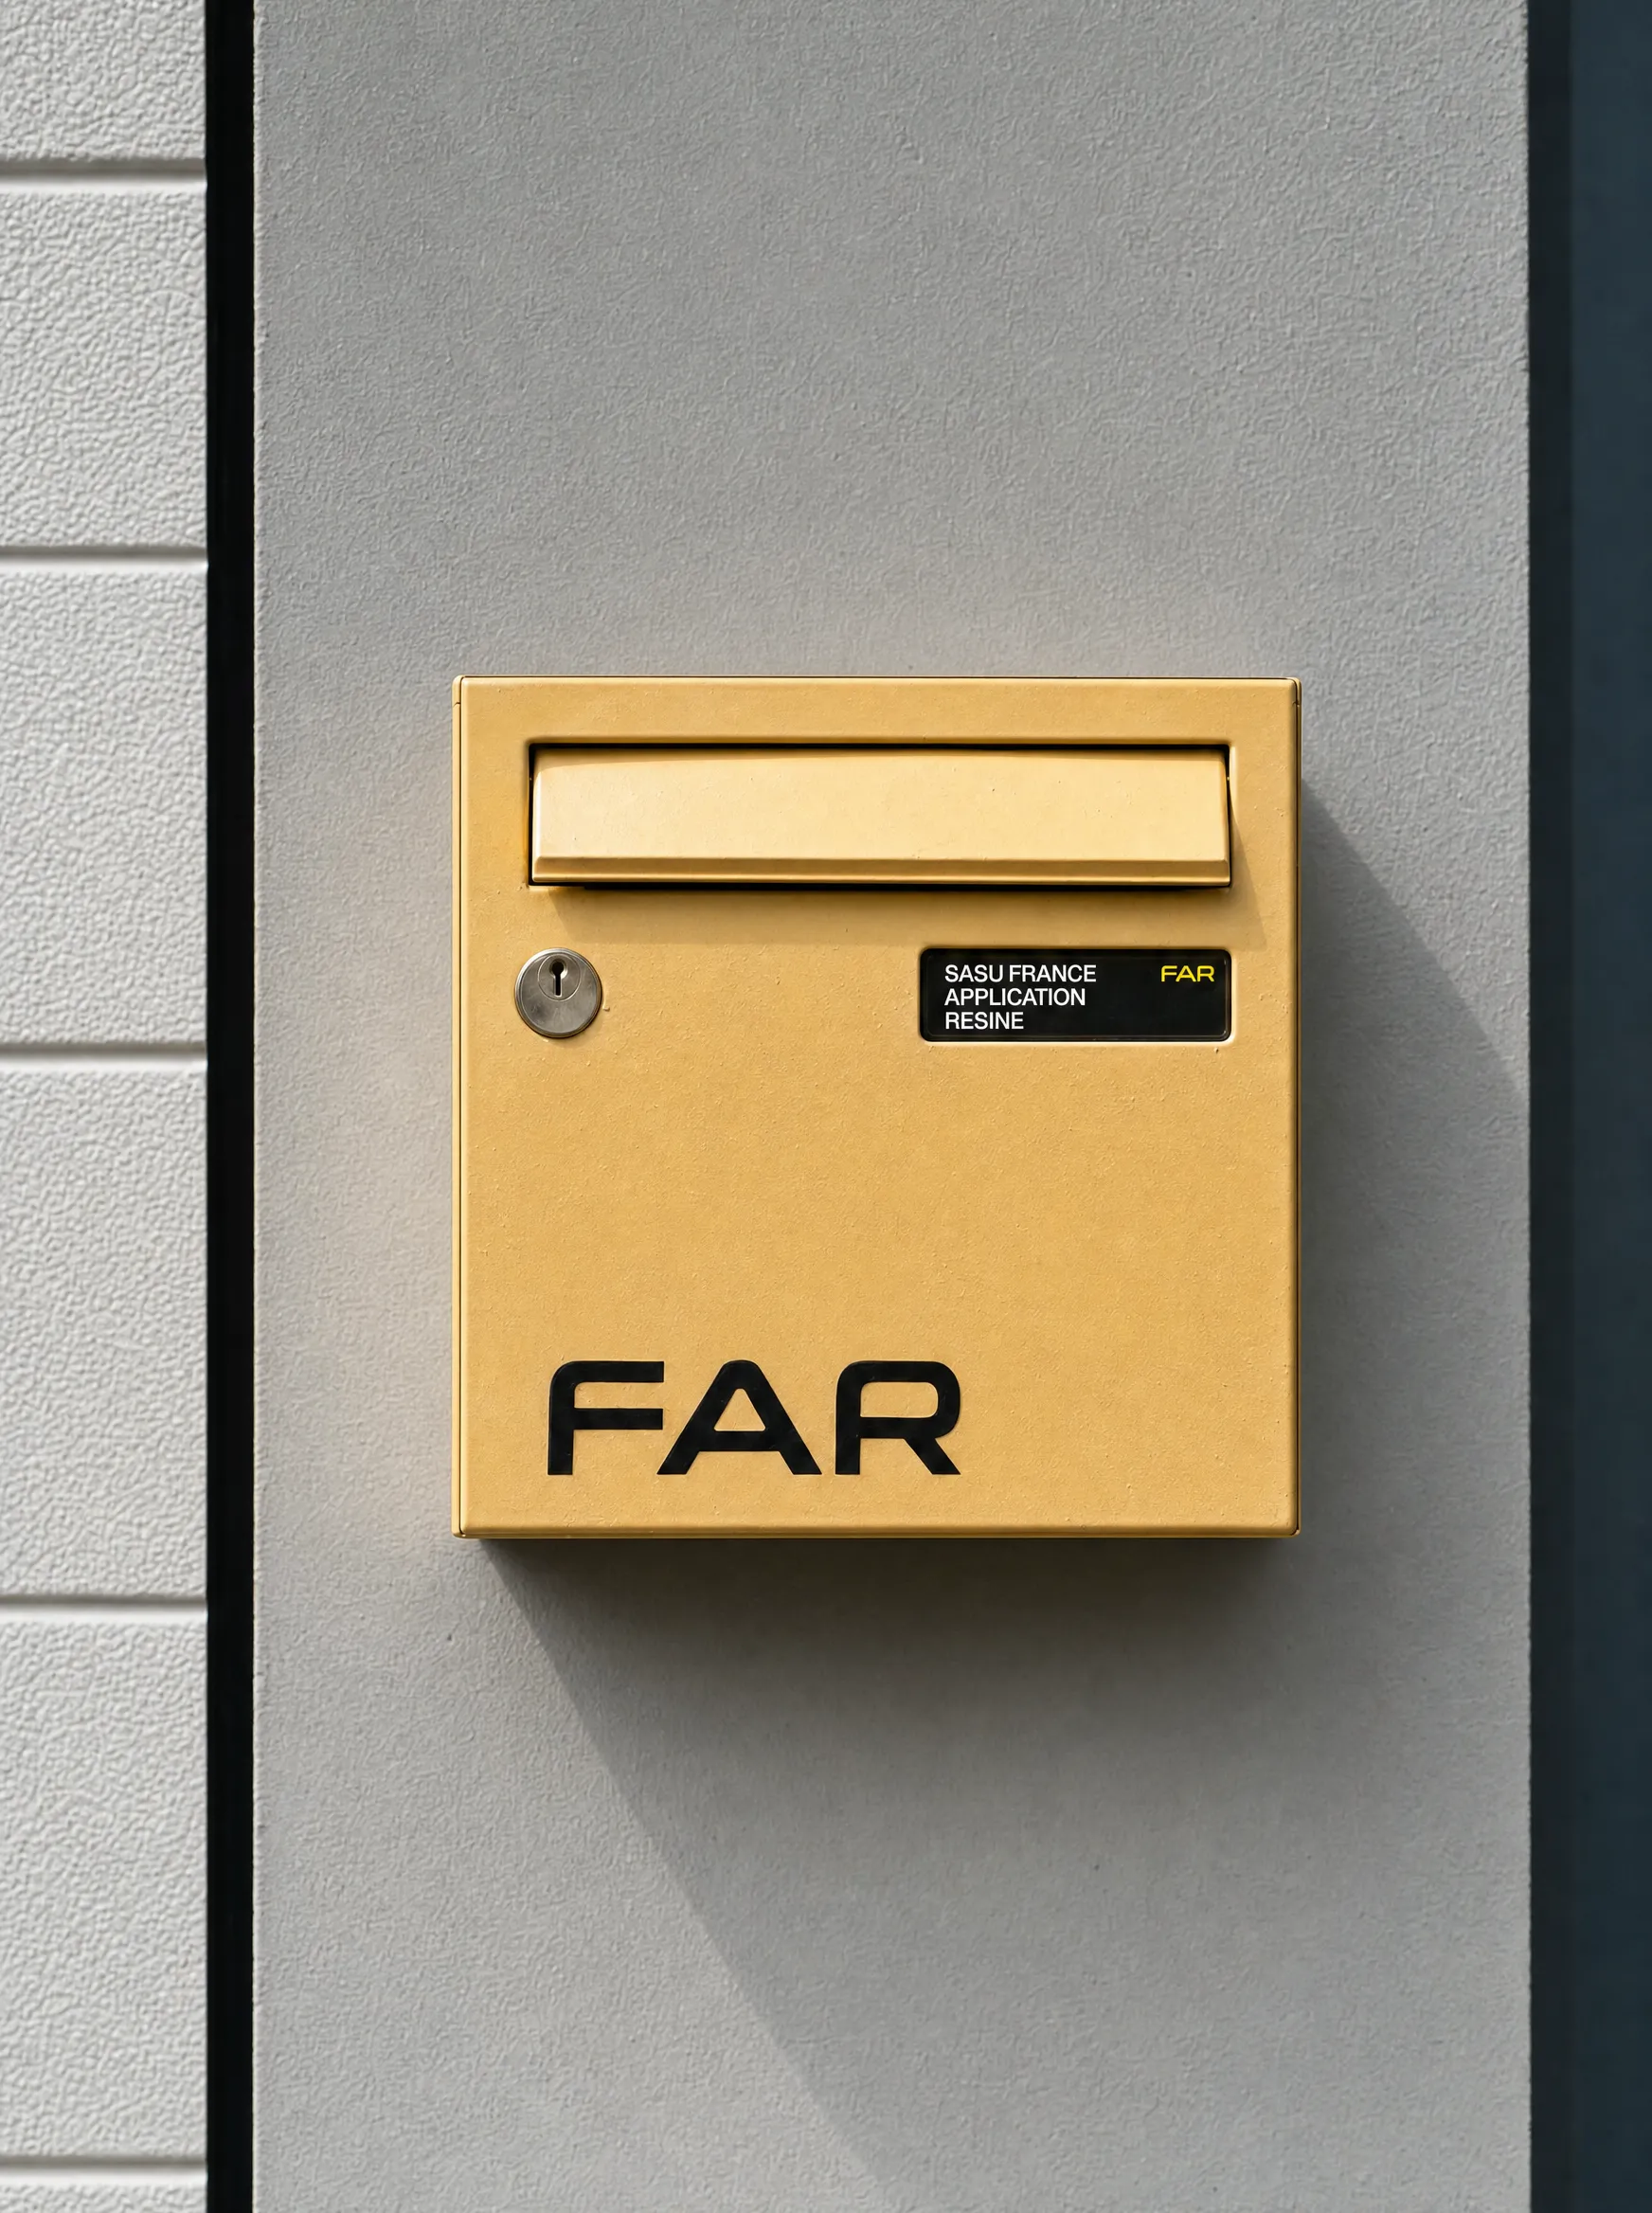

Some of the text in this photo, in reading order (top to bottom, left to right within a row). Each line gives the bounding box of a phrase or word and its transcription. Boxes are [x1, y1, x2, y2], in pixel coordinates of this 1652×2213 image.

[944, 964, 1096, 982] SASU FRANCE
[1160, 964, 1215, 982] FAR
[944, 988, 1086, 1006] APPLICATION
[945, 1012, 1024, 1030] RESINE
[548, 1360, 961, 1475] FAR
